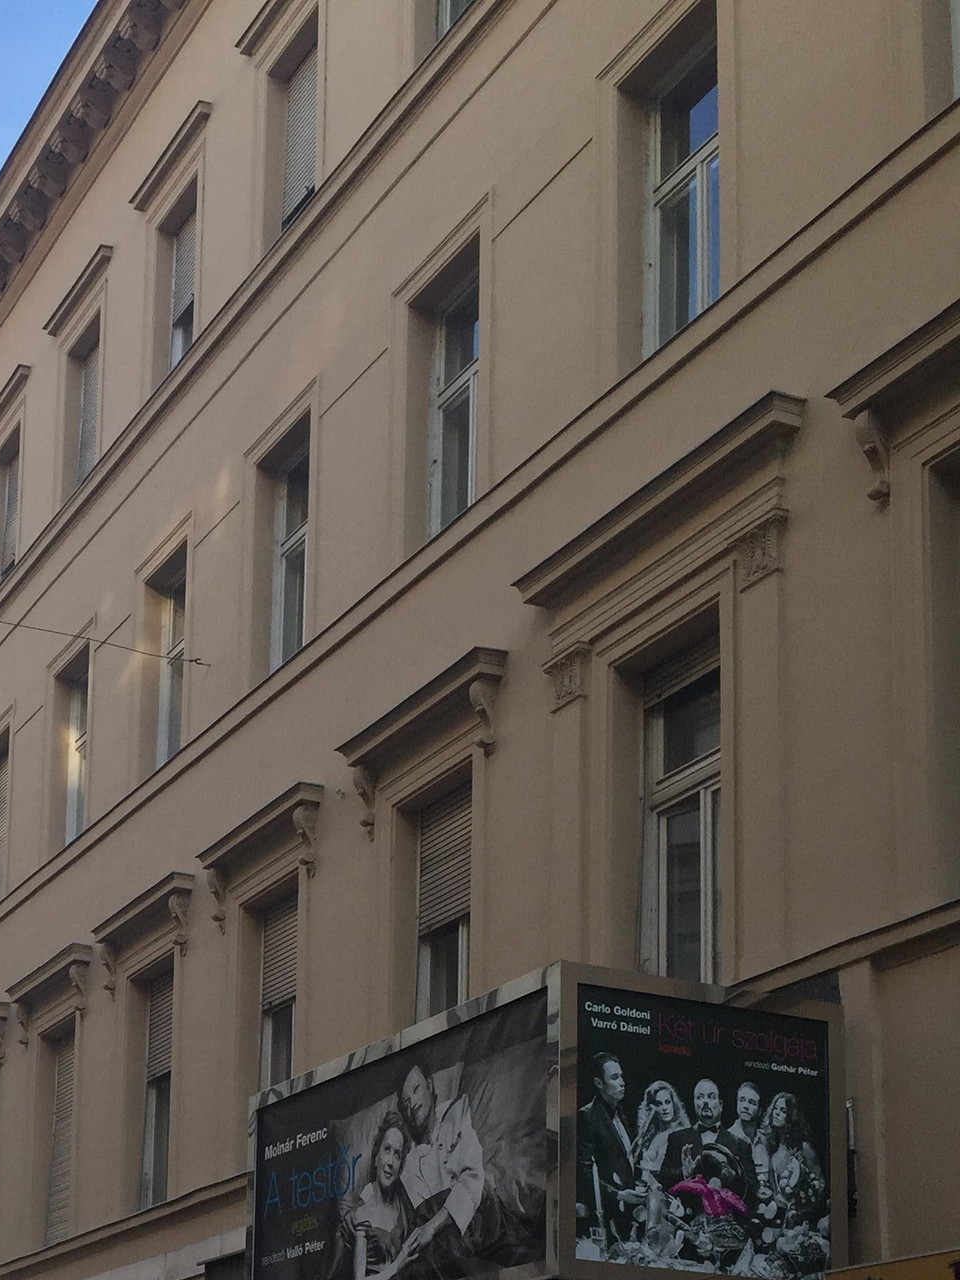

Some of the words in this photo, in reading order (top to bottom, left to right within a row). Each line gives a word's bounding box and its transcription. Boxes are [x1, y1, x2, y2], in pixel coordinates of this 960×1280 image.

[584, 1000, 611, 1017] Carlo
[613, 1005, 651, 1021] Goldoni
[590, 1016, 617, 1031] Varró
[619, 1020, 651, 1036] Dániel
[657, 1012, 694, 1041] Két
[702, 1017, 724, 1045] úr
[731, 1028, 819, 1063] szolgája
[771, 1062, 797, 1074] Gothár
[798, 1066, 820, 1077] Péter
[263, 1136, 294, 1161] Molnár
[296, 1126, 328, 1149] Ferenc
[262, 1168, 283, 1220] A
[289, 1145, 363, 1209] testőr
[286, 1243, 304, 1260] Valló
[304, 1239, 326, 1255] Péter
